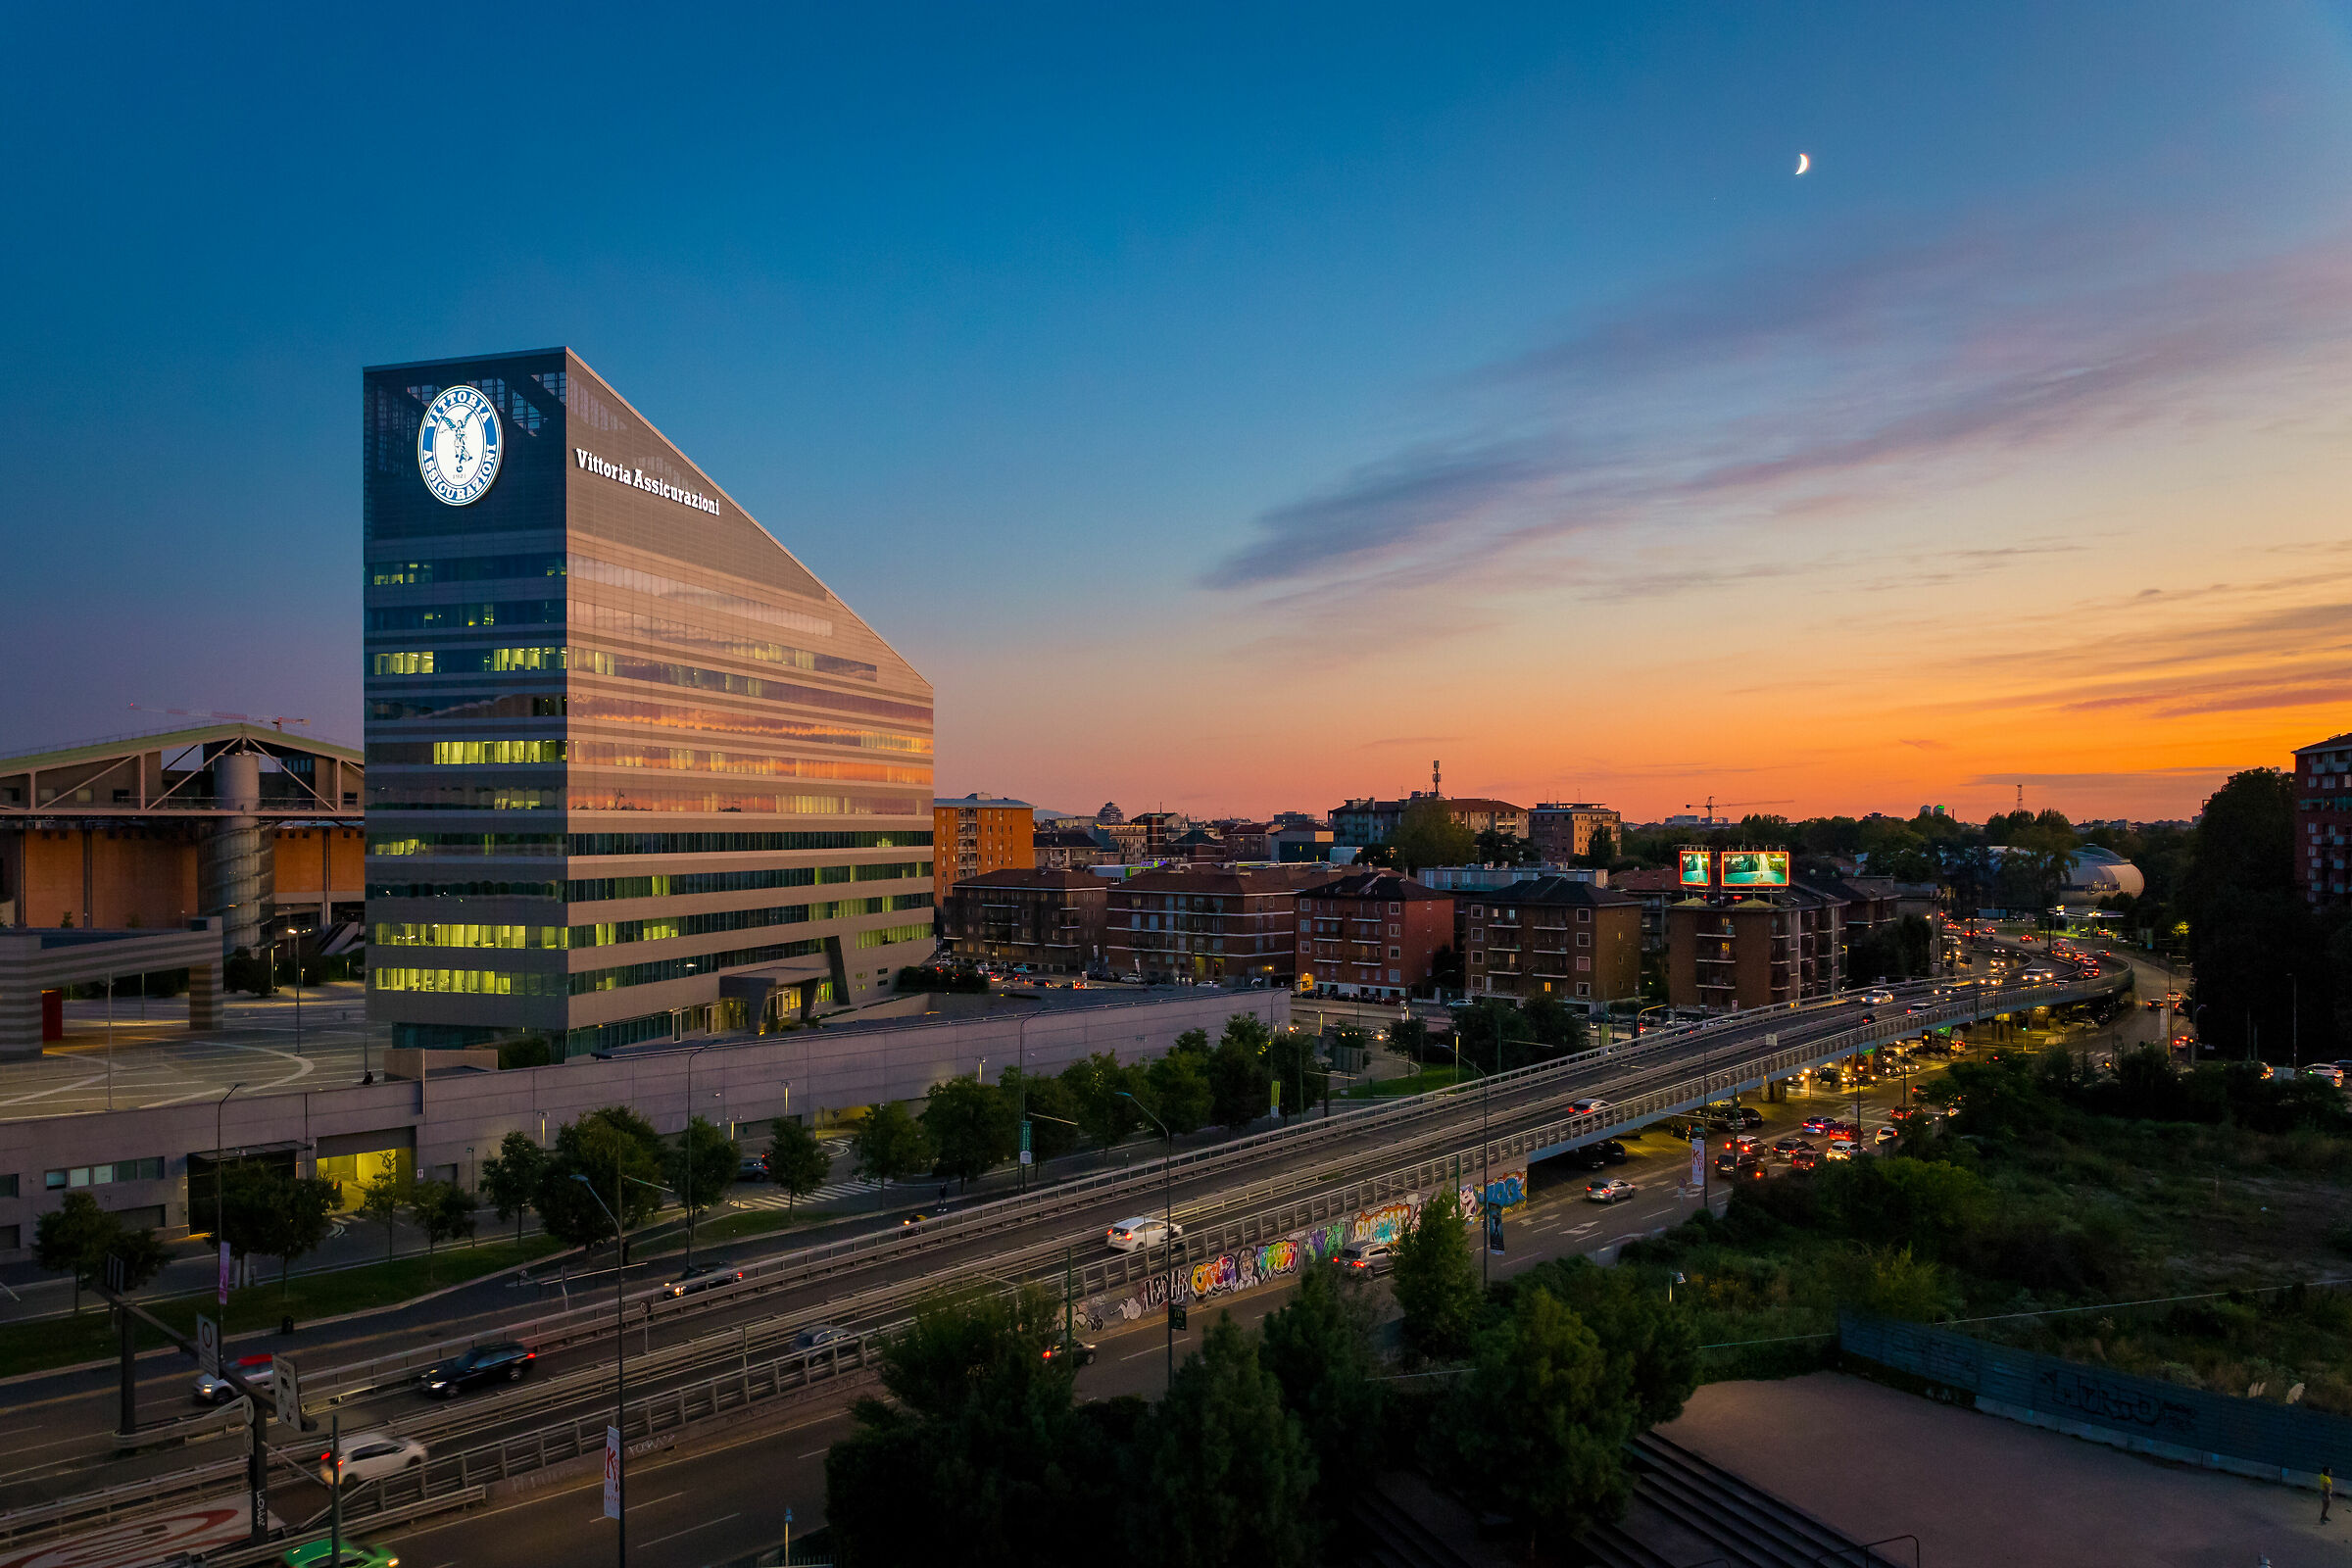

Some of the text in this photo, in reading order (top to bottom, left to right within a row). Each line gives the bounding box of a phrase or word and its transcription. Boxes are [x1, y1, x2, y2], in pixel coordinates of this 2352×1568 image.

[426, 391, 491, 427] VITTORIA
[423, 444, 496, 500] ASSICURAZIONI
[575, 447, 720, 516] Vittoria Assicurazioni
